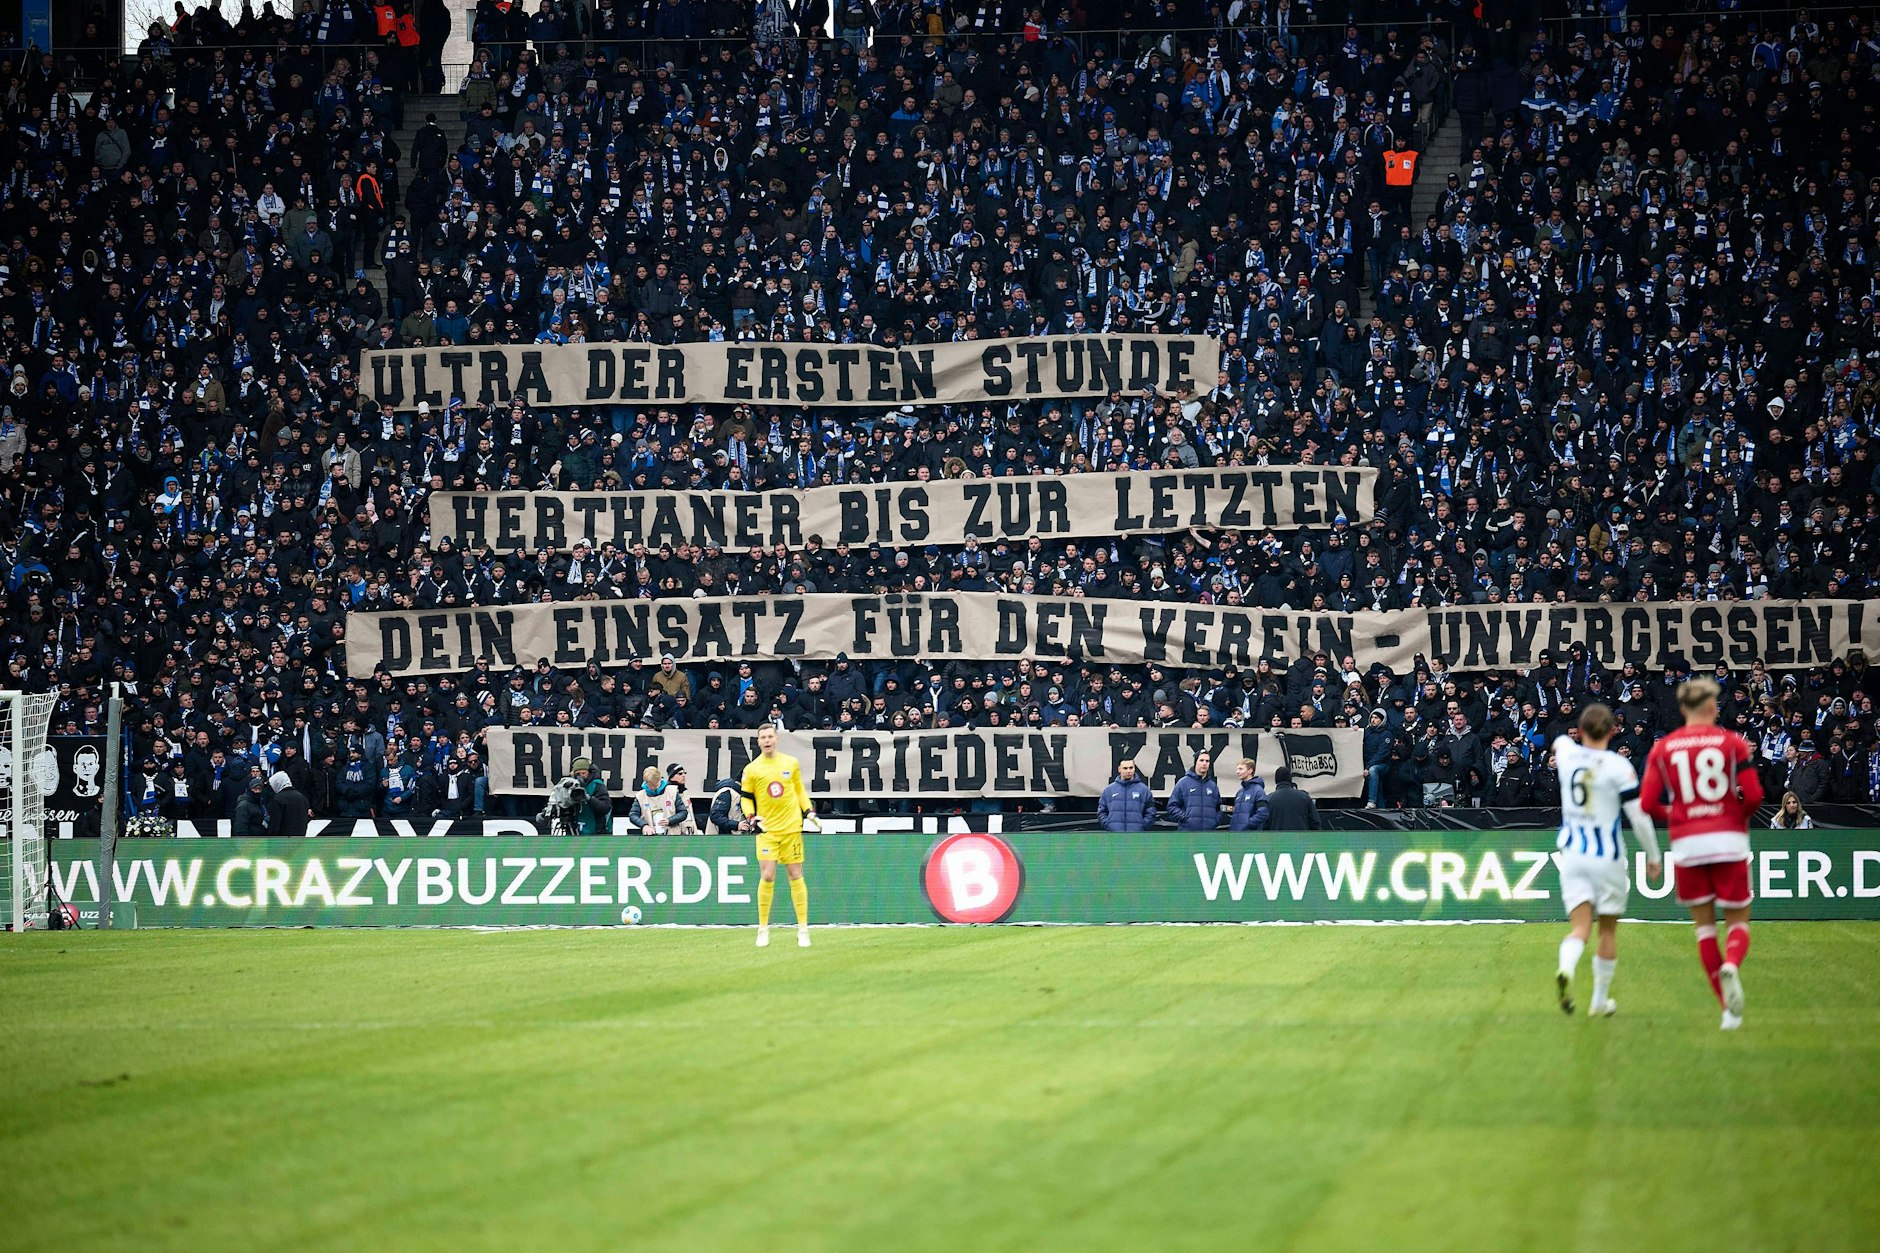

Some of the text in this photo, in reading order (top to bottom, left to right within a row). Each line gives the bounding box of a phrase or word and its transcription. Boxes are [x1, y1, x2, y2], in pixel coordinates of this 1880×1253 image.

[371, 339, 1195, 406] ULTRA DER ERSTEN STUNDE
[452, 470, 1361, 549] HERTHANER BIS ZUR LETZTEN
[379, 610, 516, 671] DEIN
[554, 599, 806, 663] EINSATZ
[852, 593, 963, 657] FÜR
[995, 599, 1107, 657] DEN
[1138, 606, 1354, 675] VEREIN
[511, 731, 665, 792] RUHE
[703, 735, 762, 792] IN
[811, 733, 1070, 792] FRIEDEN
[1671, 747, 1730, 805] 18
[946, 849, 999, 912] B
